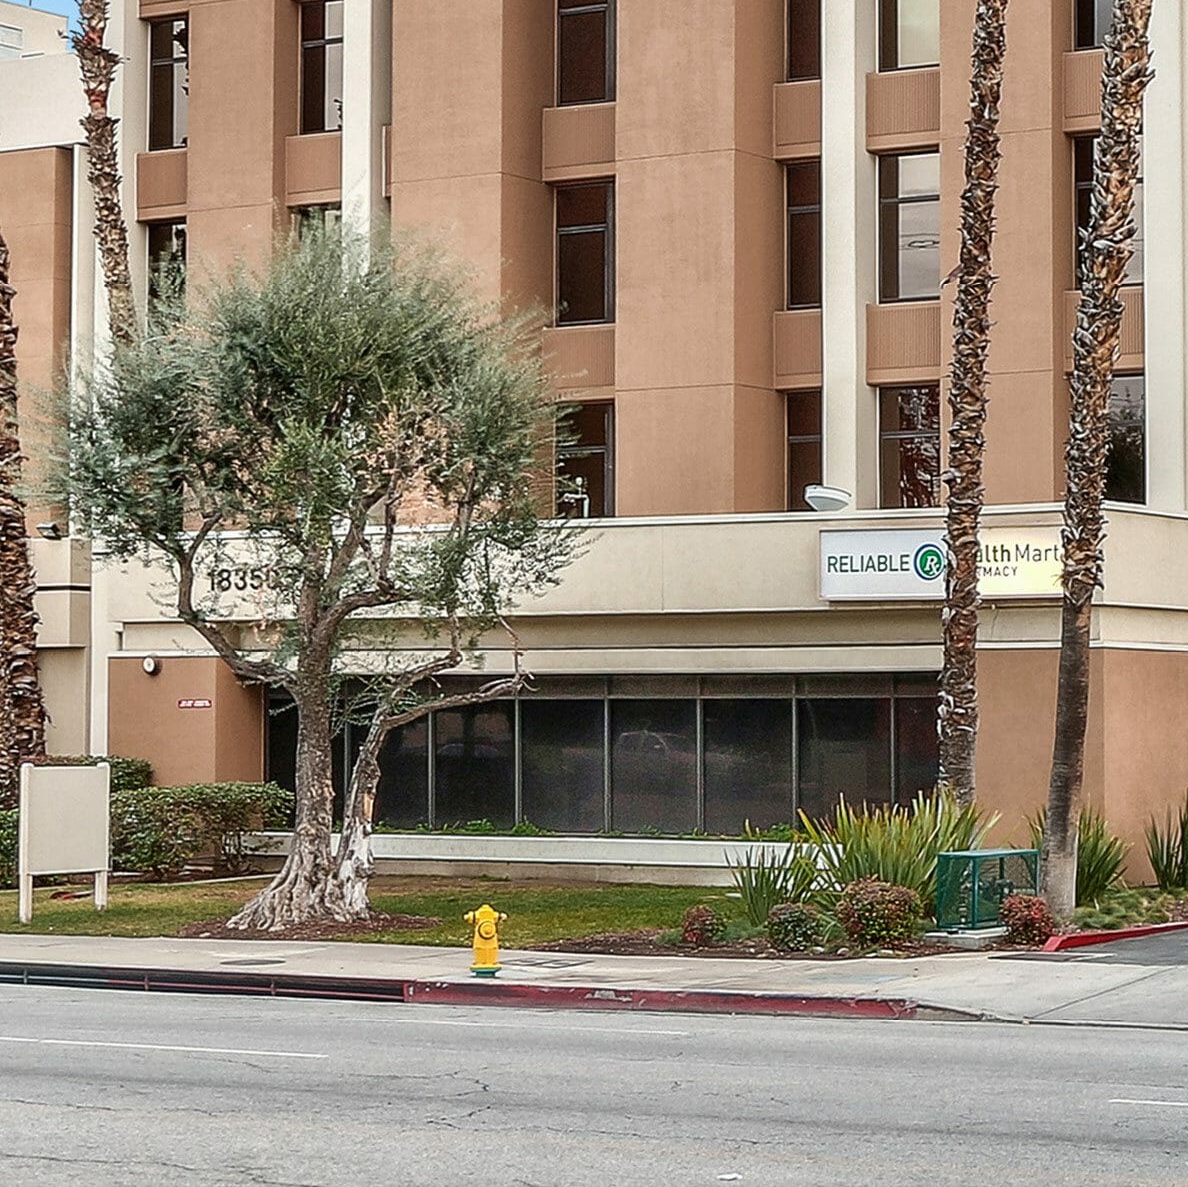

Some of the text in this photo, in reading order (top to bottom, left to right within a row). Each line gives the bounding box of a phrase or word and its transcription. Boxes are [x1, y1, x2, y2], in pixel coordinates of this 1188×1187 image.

[827, 554, 911, 573] RELIABLE
[976, 544, 1011, 563] alth
[1015, 543, 1060, 563] Mart
[977, 565, 1018, 577] MACY
